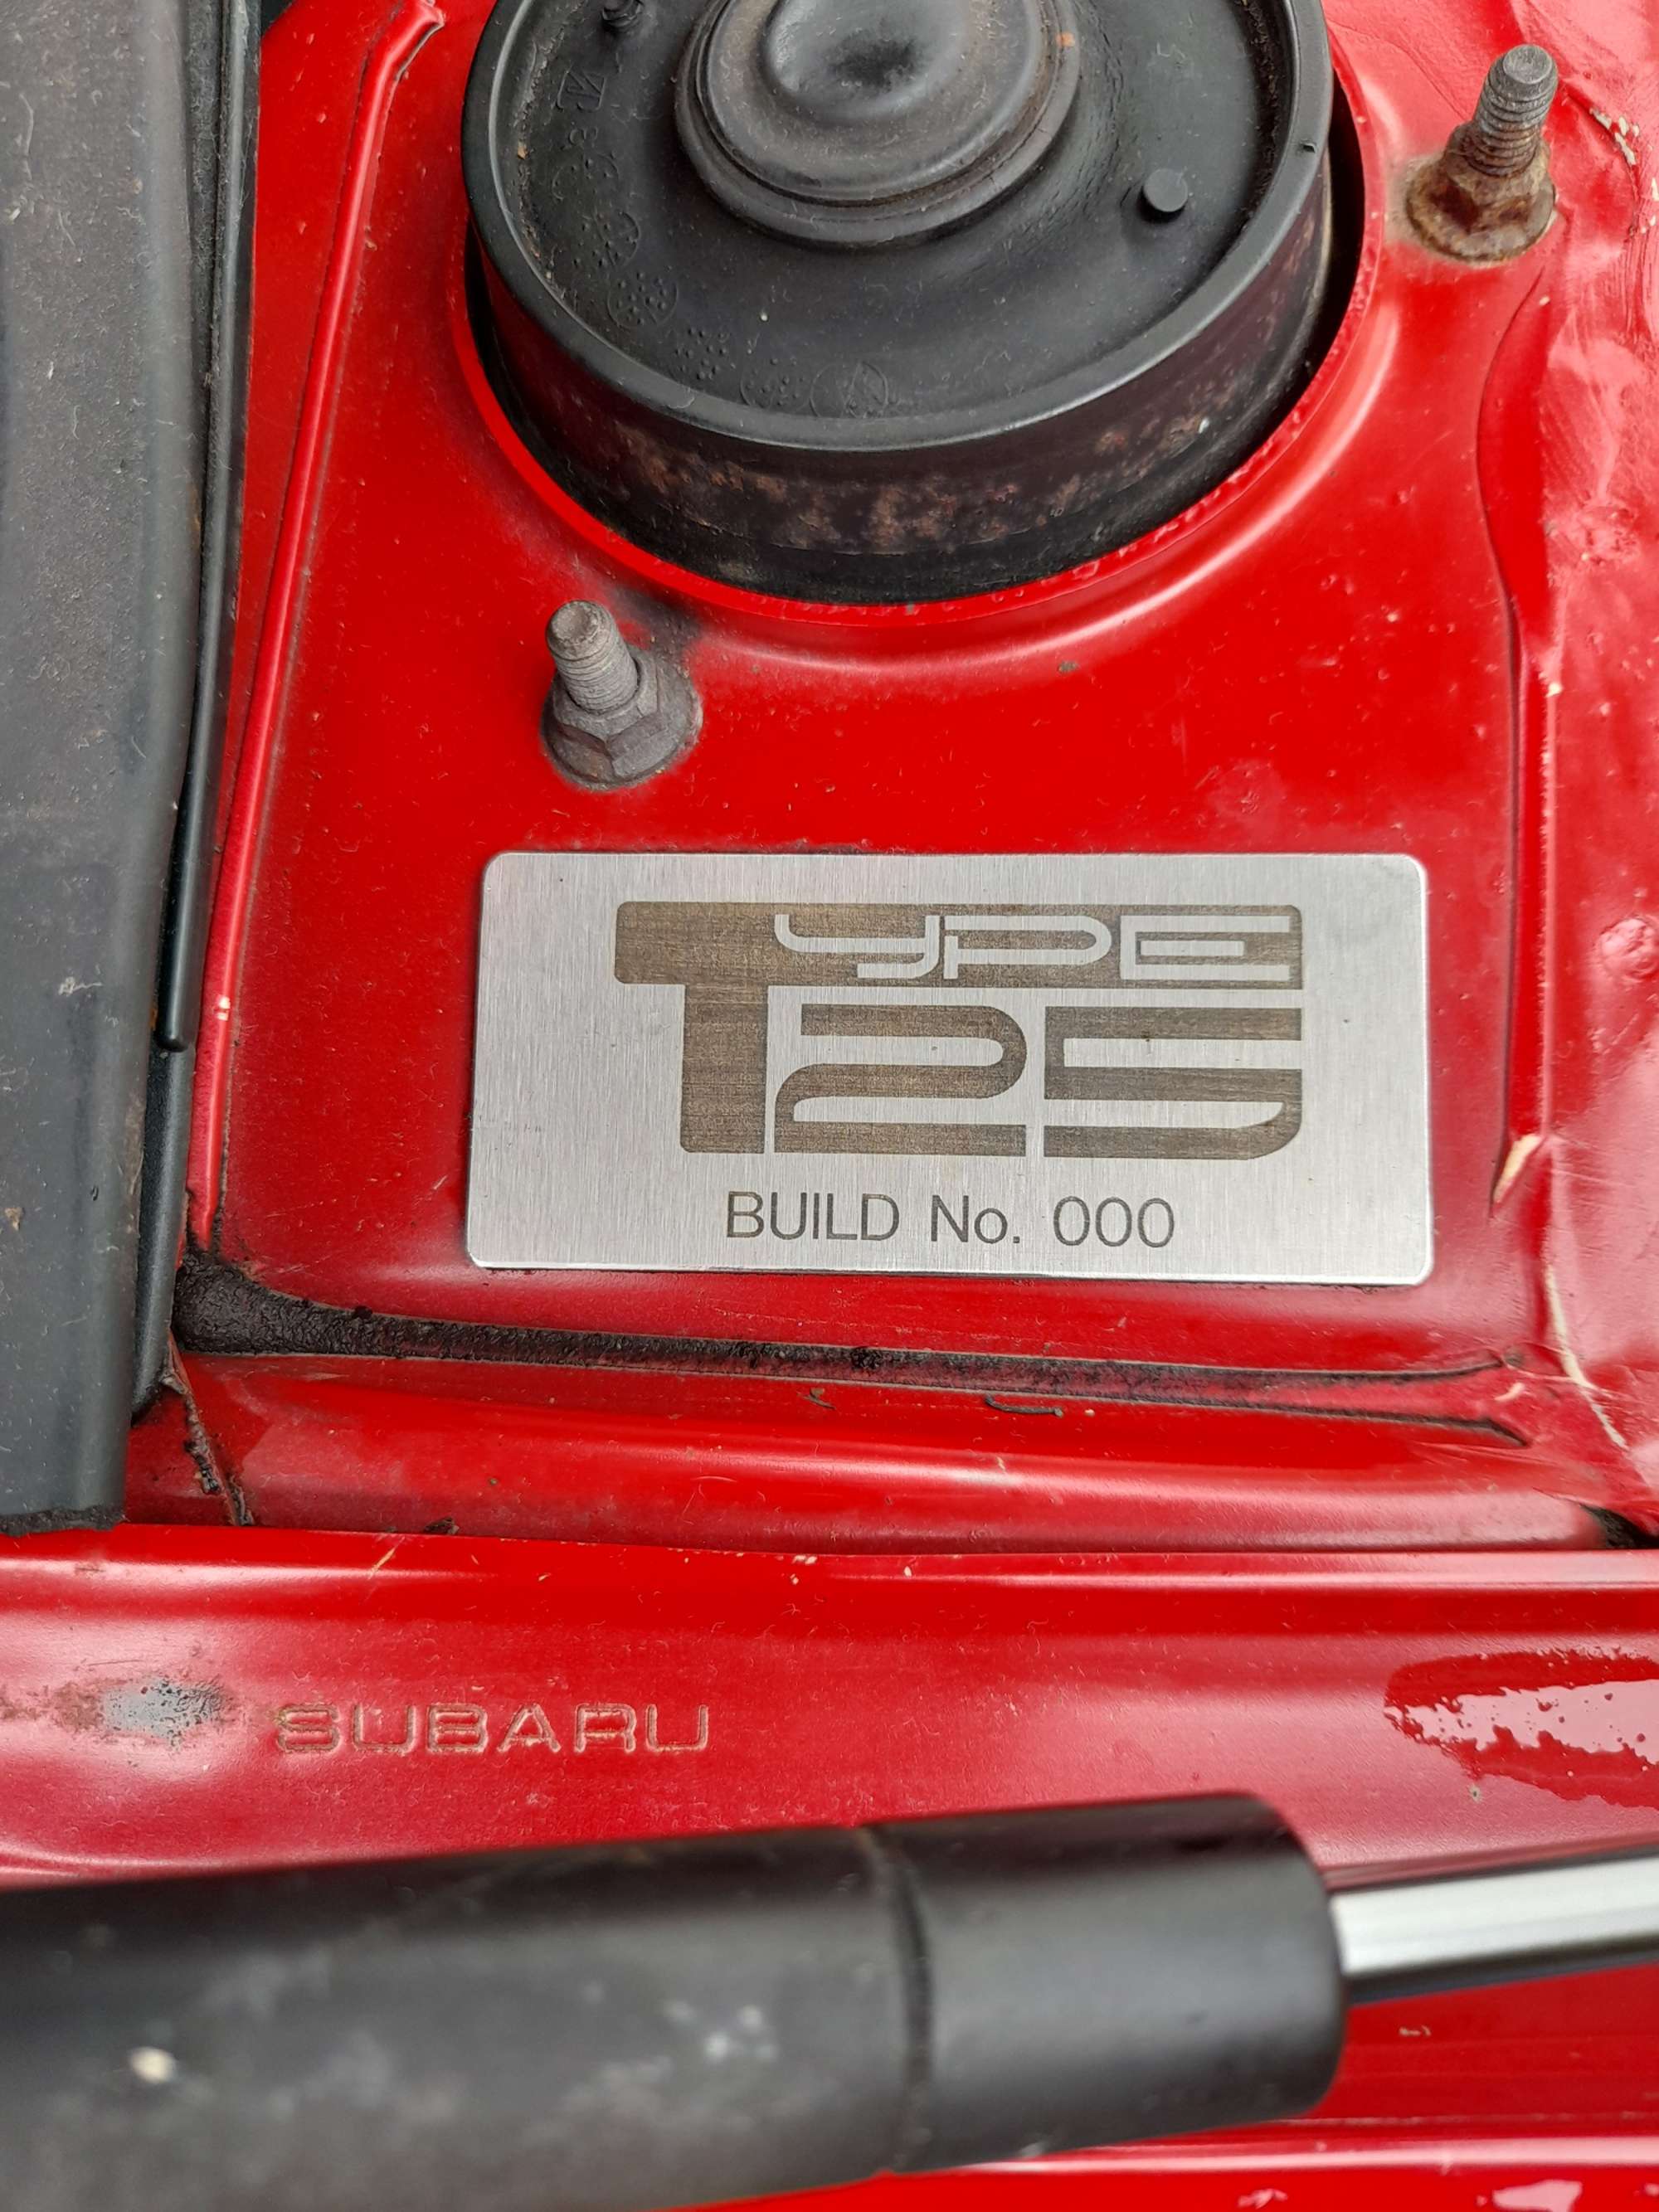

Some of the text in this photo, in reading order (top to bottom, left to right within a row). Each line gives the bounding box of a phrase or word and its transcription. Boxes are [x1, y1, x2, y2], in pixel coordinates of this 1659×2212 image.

[726, 1190, 1175, 1248] BUILD No. 000
[275, 1703, 711, 1757] SUBARU
